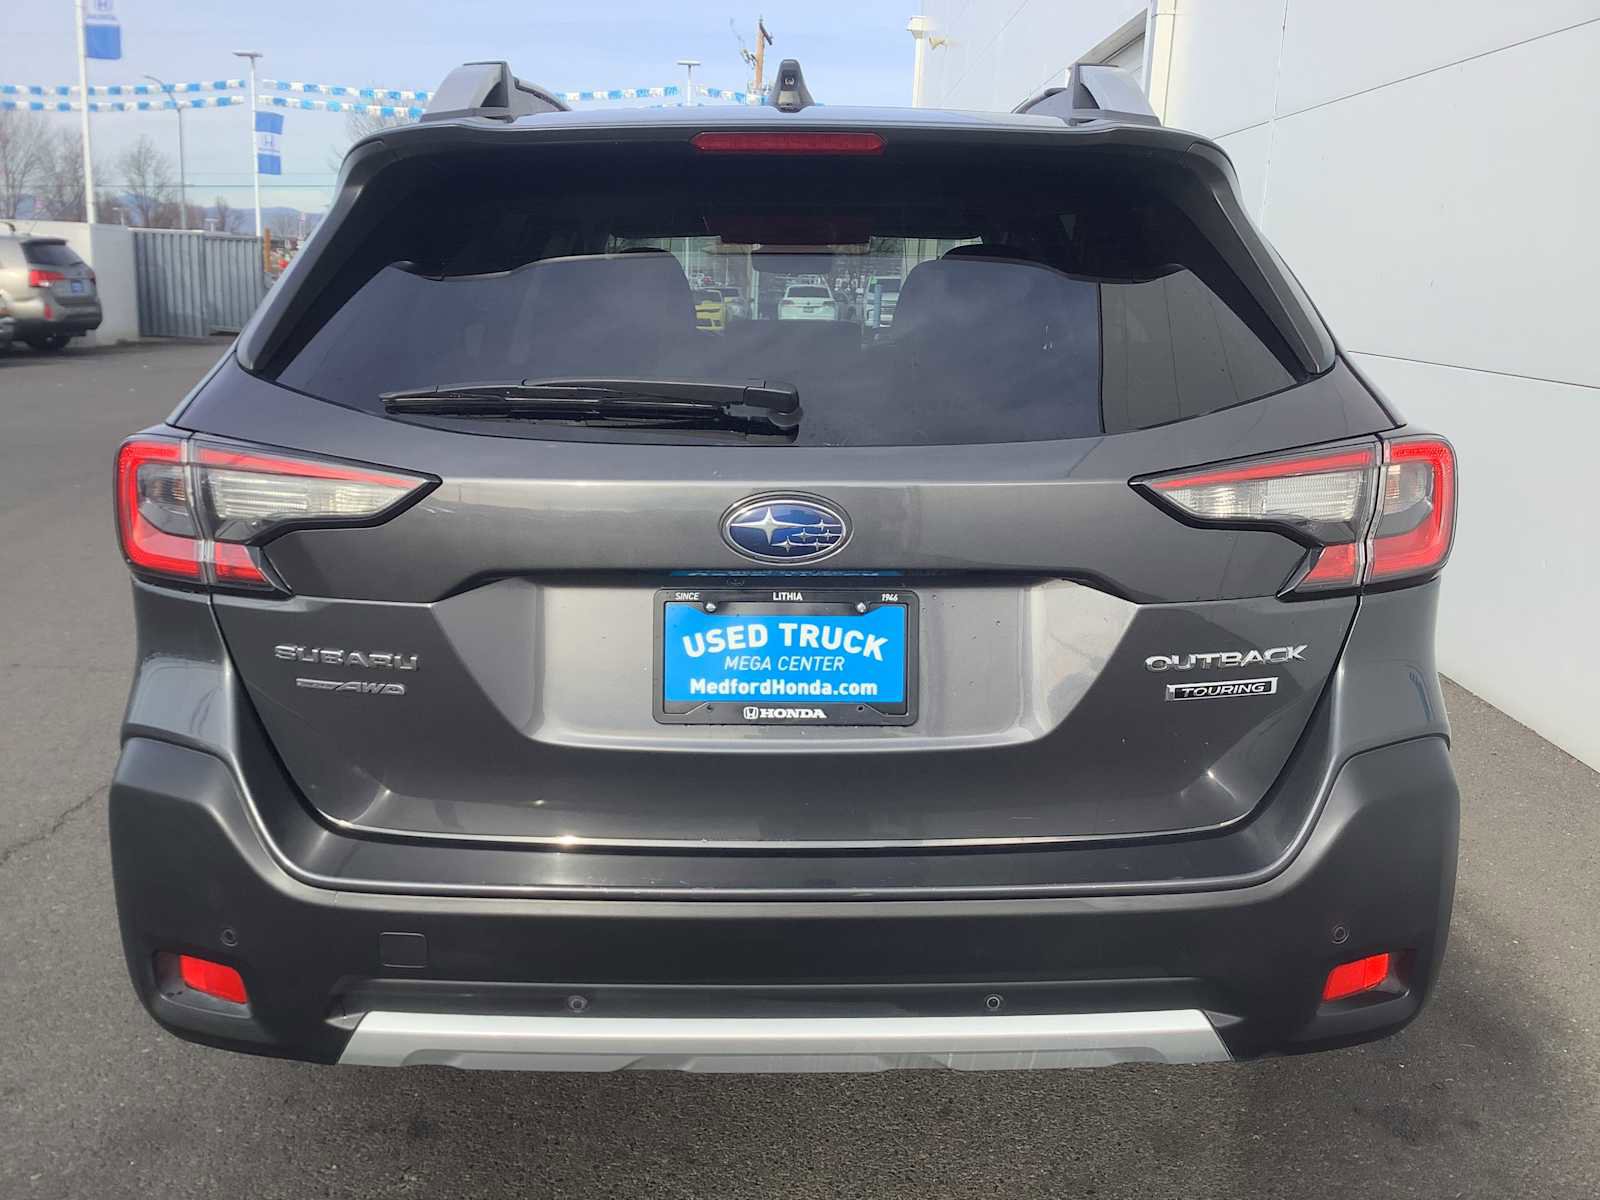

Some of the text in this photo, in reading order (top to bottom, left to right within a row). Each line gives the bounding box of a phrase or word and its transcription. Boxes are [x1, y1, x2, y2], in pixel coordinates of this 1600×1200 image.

[675, 592, 700, 601] SINCE
[772, 592, 803, 601] LITHIA
[881, 594, 899, 602] 1946
[682, 623, 889, 662] USED TRUCK
[275, 645, 417, 671] SUBARU
[724, 656, 846, 671] MEGA CENTER
[1145, 645, 1308, 671] OUTBACK
[336, 681, 405, 695] AWD
[690, 678, 878, 695] MedfordHonda.com
[1181, 682, 1266, 698] TOURING
[759, 708, 828, 719] HONDA
